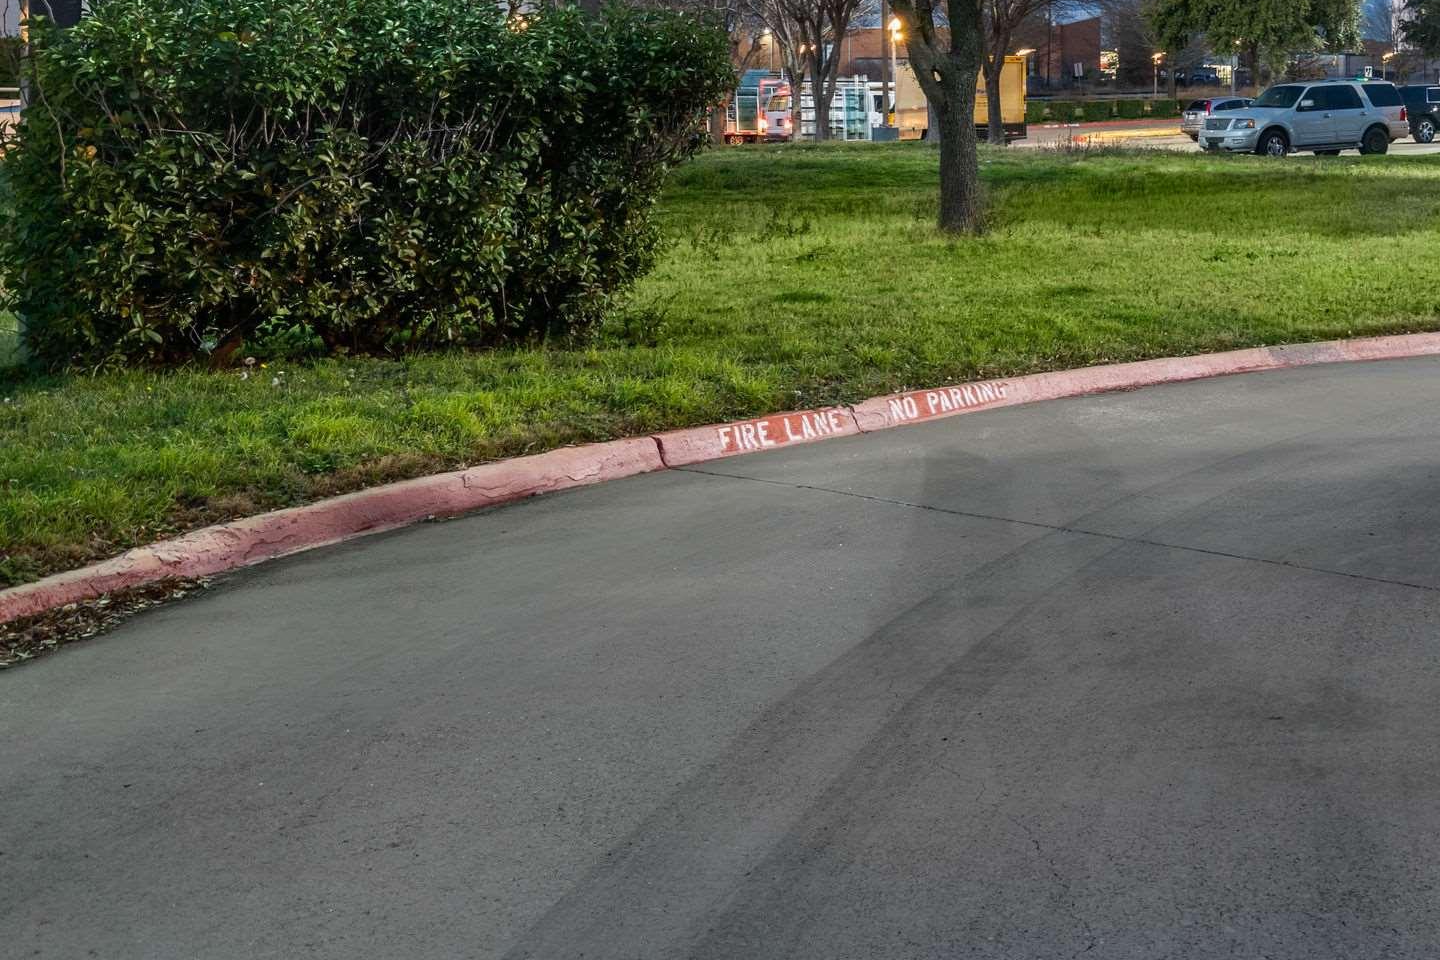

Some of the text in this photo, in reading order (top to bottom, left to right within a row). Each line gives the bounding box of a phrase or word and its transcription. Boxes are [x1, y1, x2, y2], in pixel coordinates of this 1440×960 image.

[718, 381, 1007, 449] FIRE LANE NO PARKING
